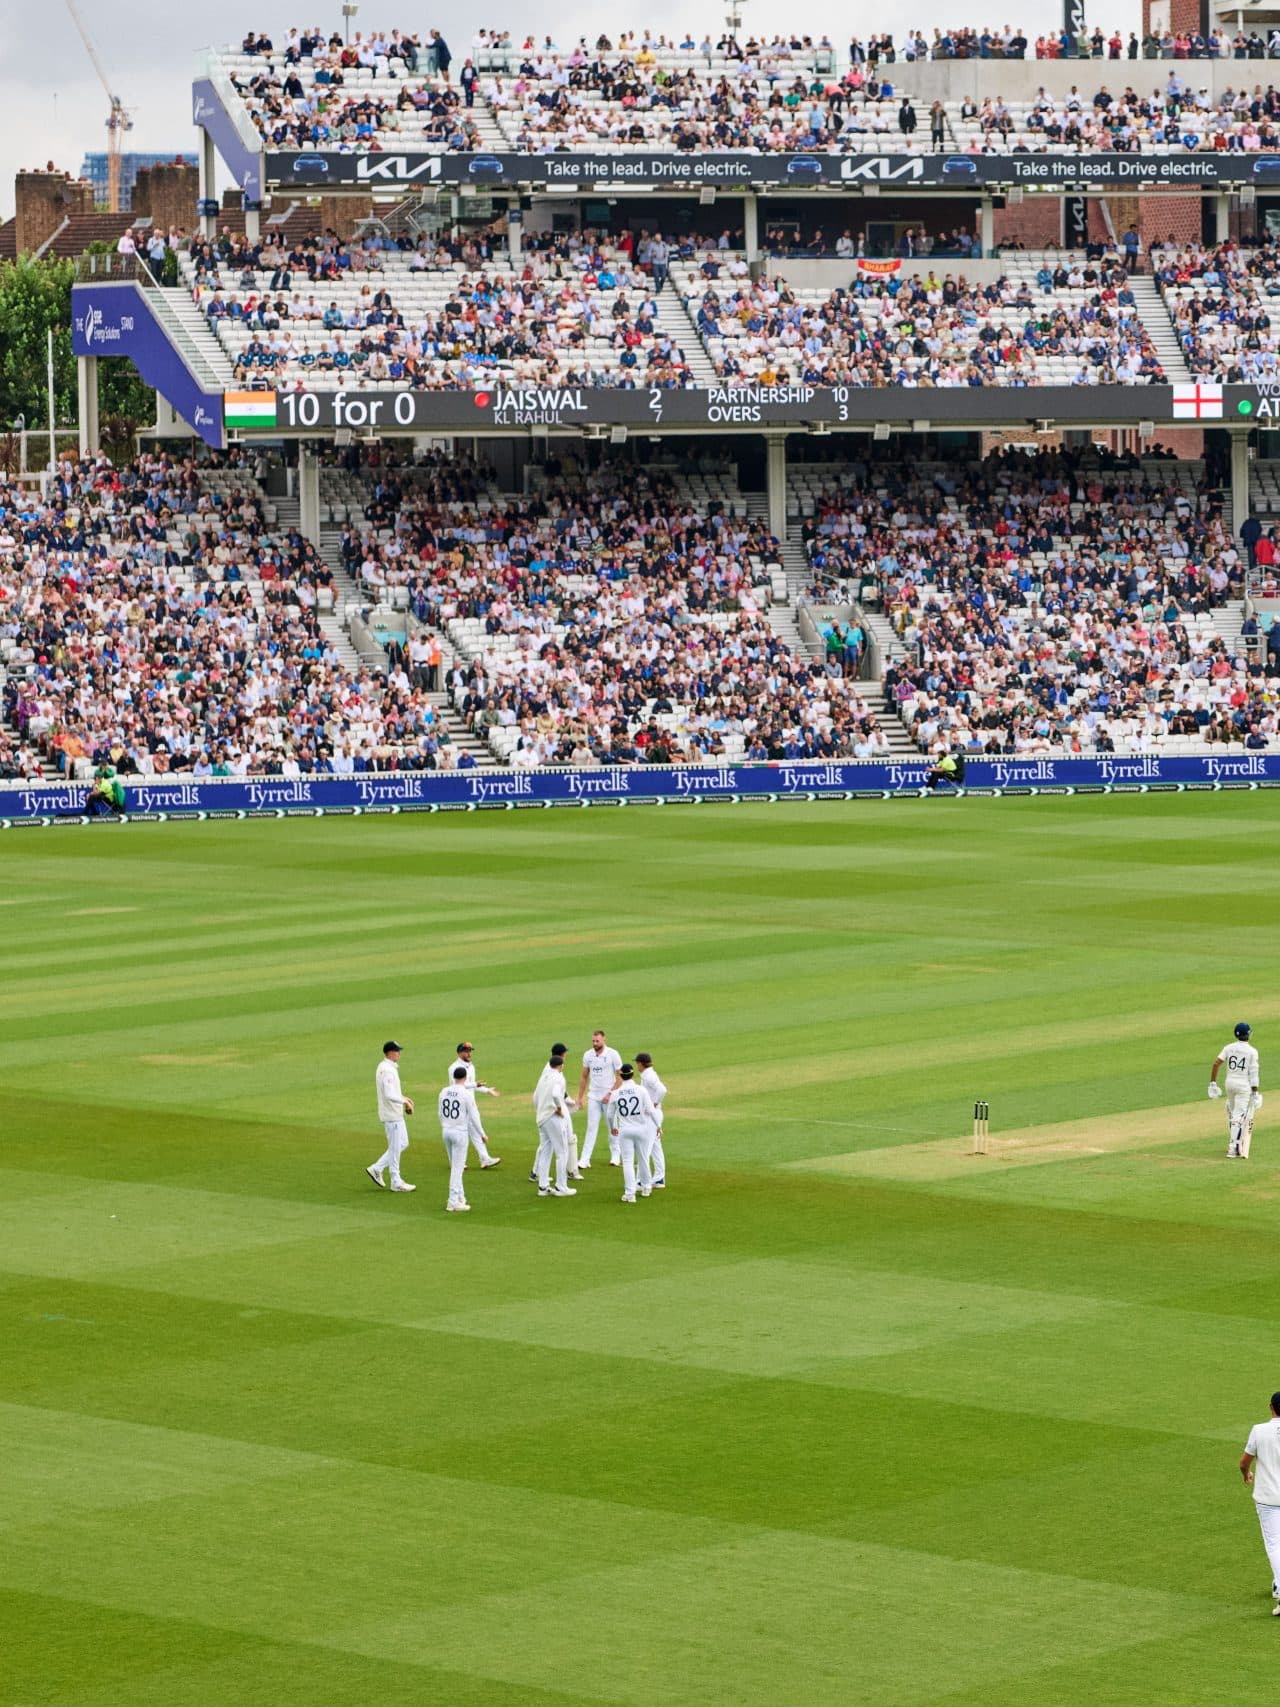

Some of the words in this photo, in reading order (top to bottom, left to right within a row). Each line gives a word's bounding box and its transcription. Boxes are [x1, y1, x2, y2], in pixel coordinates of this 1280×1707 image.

[357, 157, 441, 178] KIA
[544, 161, 580, 176] Take
[584, 161, 609, 176] the
[612, 161, 648, 176] lead.
[652, 161, 691, 176] Drive
[694, 161, 752, 176] electric.
[841, 158, 923, 179] KIA
[1013, 161, 1048, 176] Take
[1051, 161, 1076, 176] the
[1080, 161, 1115, 176] lead.
[1119, 161, 1157, 176] Drive
[1160, 161, 1217, 176] electric.
[493, 390, 588, 411] JAISWAL
[649, 389, 662, 409] 2
[708, 388, 814, 404] PARTNERSHIP
[832, 388, 848, 403] 10
[282, 393, 320, 426] 10
[332, 392, 383, 426] for
[394, 393, 416, 426] 0
[494, 411, 509, 424] KL
[515, 411, 562, 424] RAHUL
[653, 410, 662, 423] 7
[708, 406, 761, 422] OVERS
[839, 406, 848, 421] 3
[779, 767, 842, 792] Tyrrells
[885, 764, 943, 790] Tyrre
[991, 761, 1054, 787] Tyrrells
[1097, 759, 1160, 785] Tyrrells
[1202, 757, 1265, 782] Tyrrells
[356, 779, 421, 806] Tyrrells
[466, 776, 532, 802] Tyrrells
[564, 773, 628, 799] Tyrrells
[672, 769, 736, 796] Tyrrells
[19, 789, 86, 817] Tyrrells
[132, 786, 200, 813] Tyrrells
[245, 782, 311, 810] Tyrrells
[1228, 1055, 1246, 1071] 64
[442, 1098, 460, 1119] 88
[617, 1096, 640, 1117] 82
